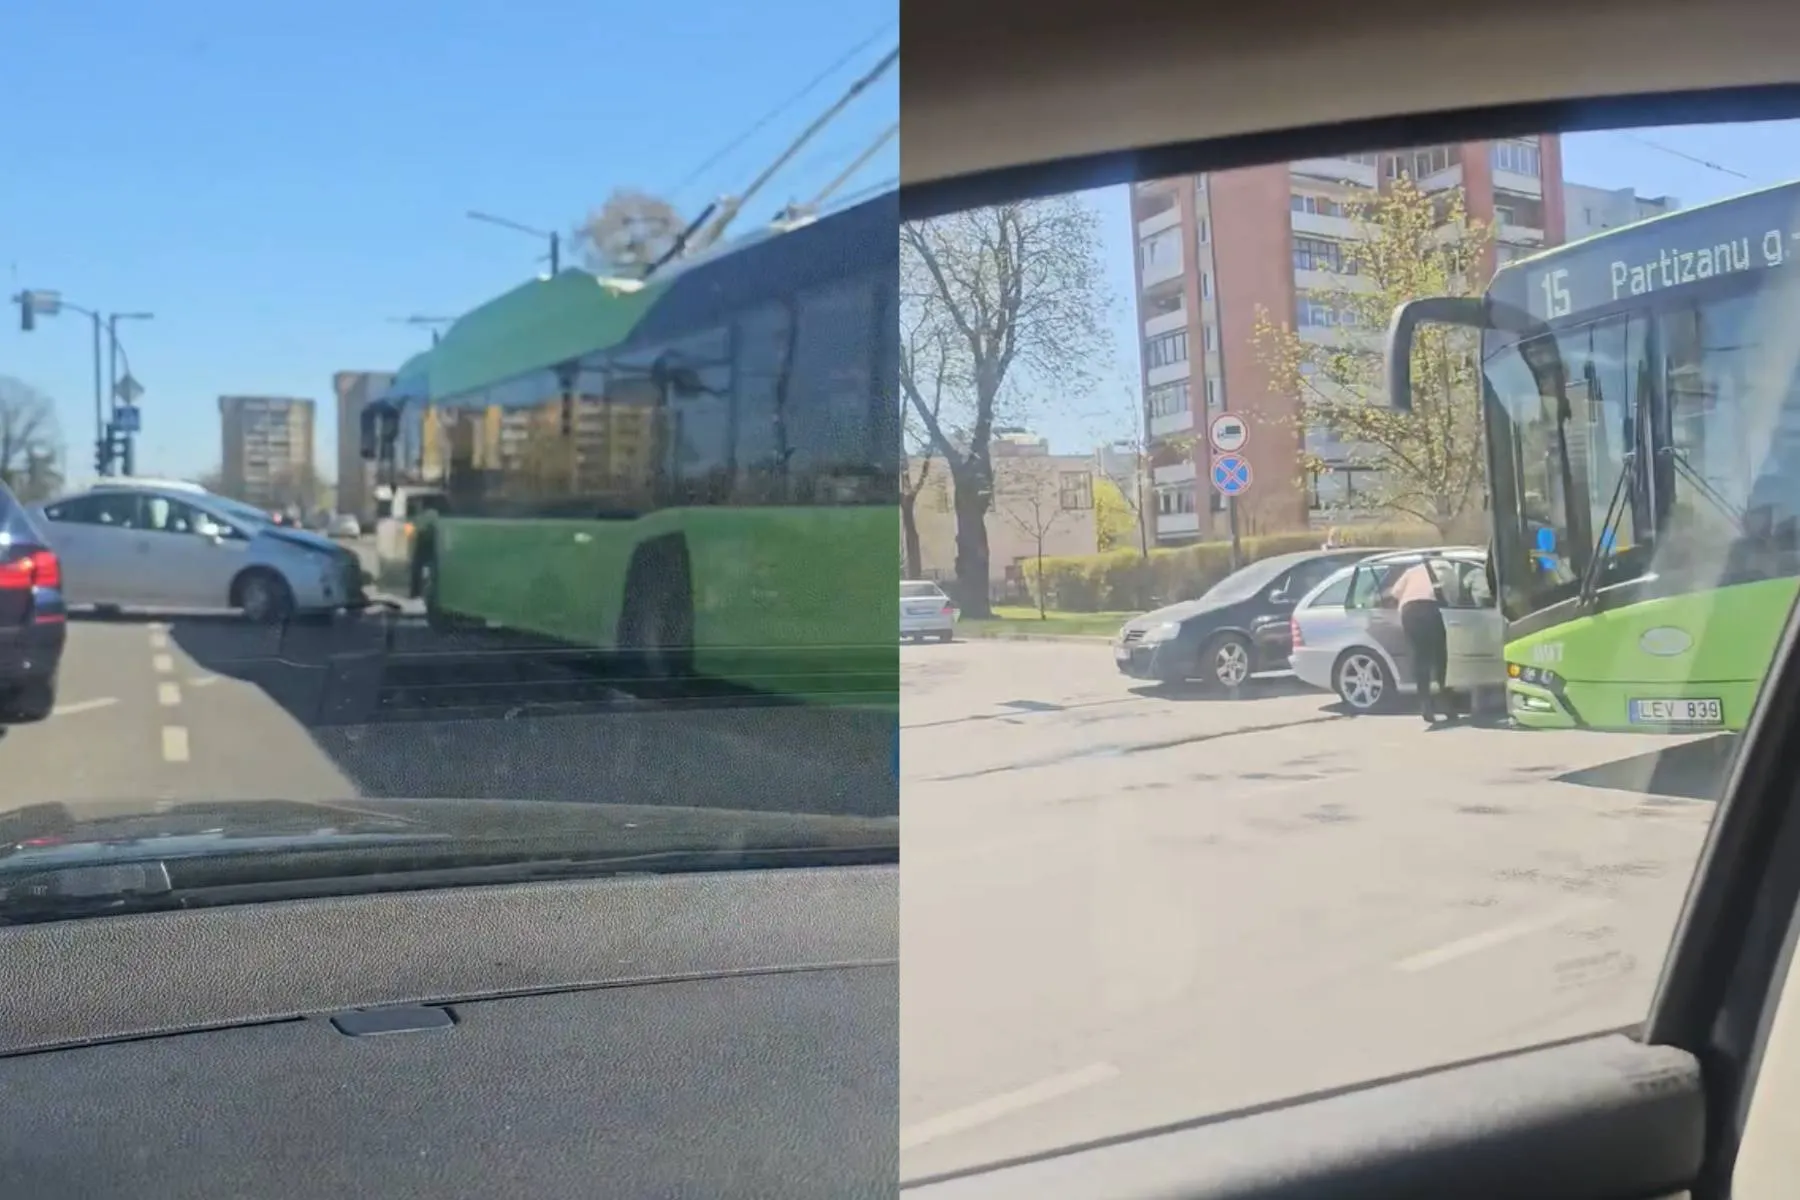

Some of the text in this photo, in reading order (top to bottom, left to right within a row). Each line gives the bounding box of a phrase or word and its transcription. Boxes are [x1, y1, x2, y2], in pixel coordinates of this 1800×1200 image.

[1540, 267, 1571, 319] 15
[1610, 236, 1749, 299] Partizanu
[1640, 702, 1718, 718] LEV 839
